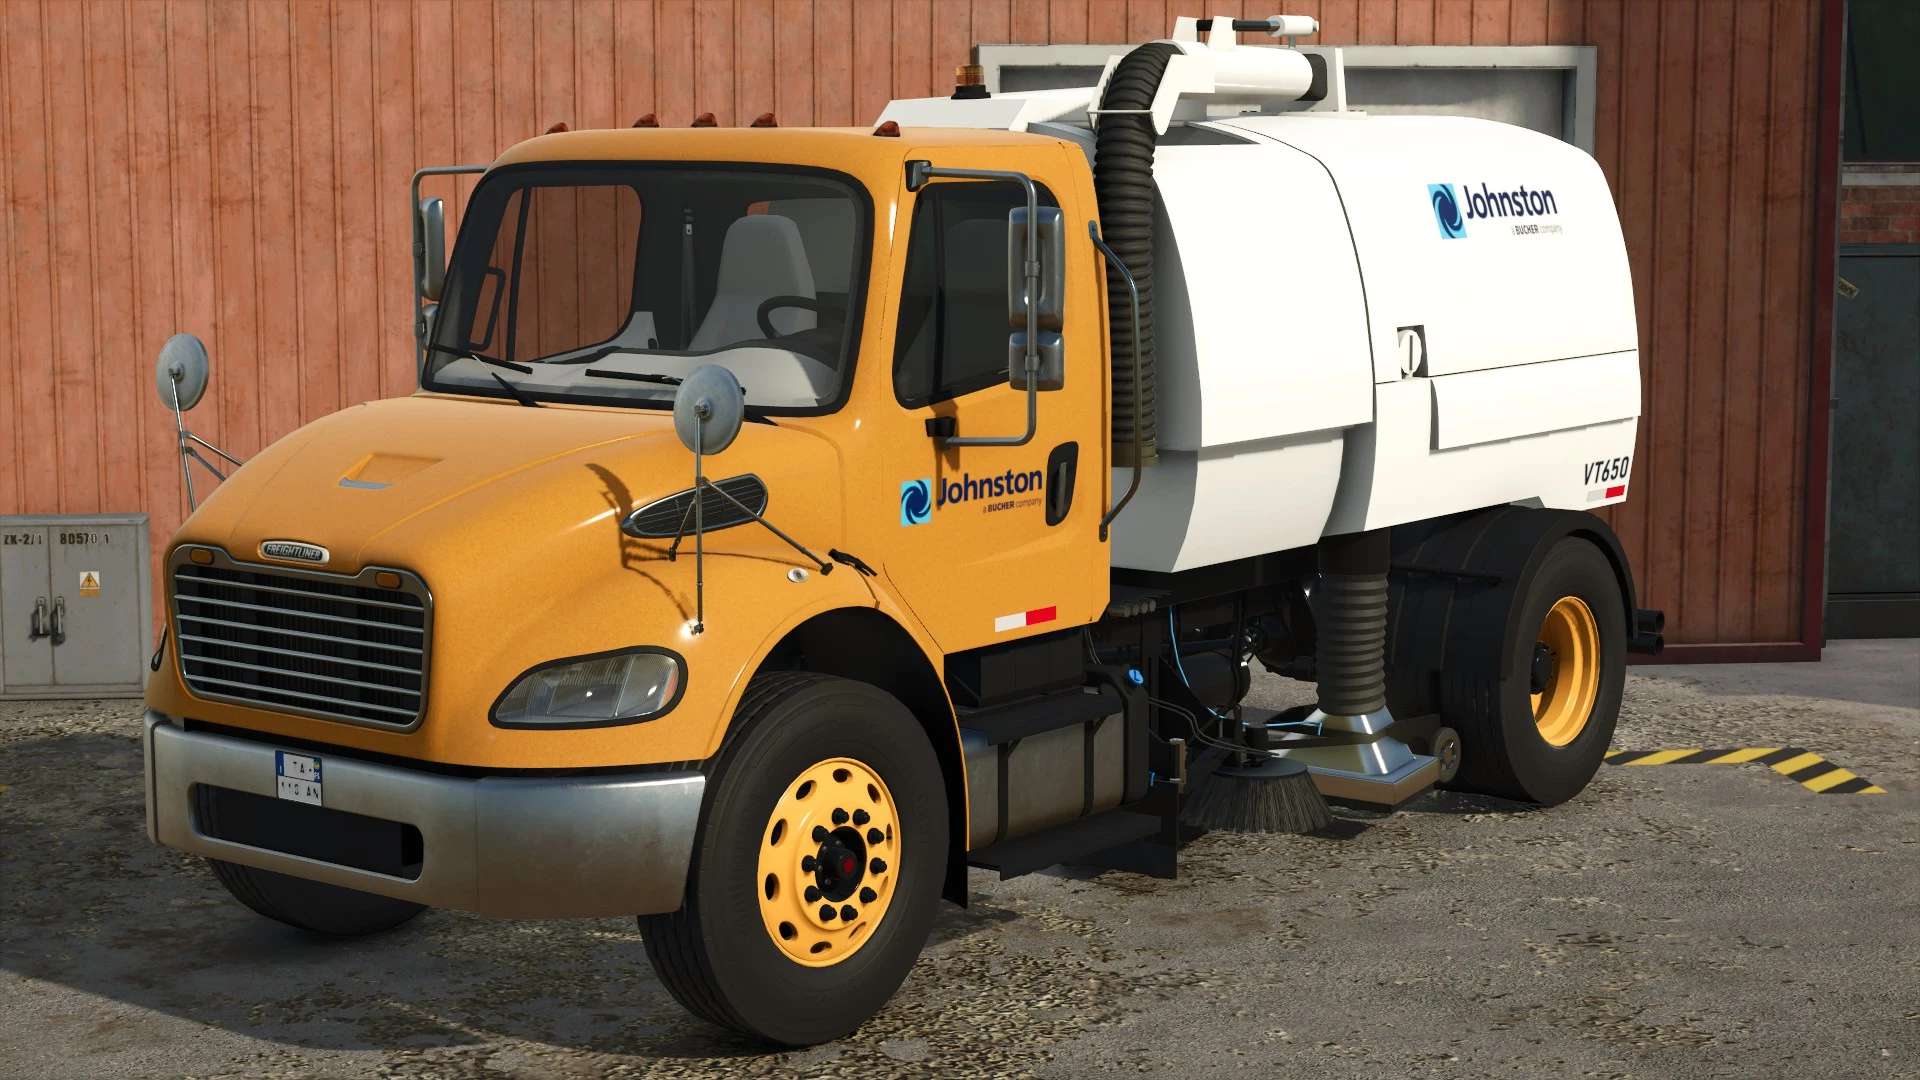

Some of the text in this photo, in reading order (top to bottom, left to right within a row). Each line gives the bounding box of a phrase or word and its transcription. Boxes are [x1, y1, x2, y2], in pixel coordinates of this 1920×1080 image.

[1463, 182, 1558, 219] Johnston
[1515, 224, 1539, 236] BUCHER
[1584, 456, 1630, 486] VT650
[936, 469, 1043, 507] Johnston
[987, 500, 1015, 513] BUCHER
[266, 544, 321, 560] FREIGHTLINER
